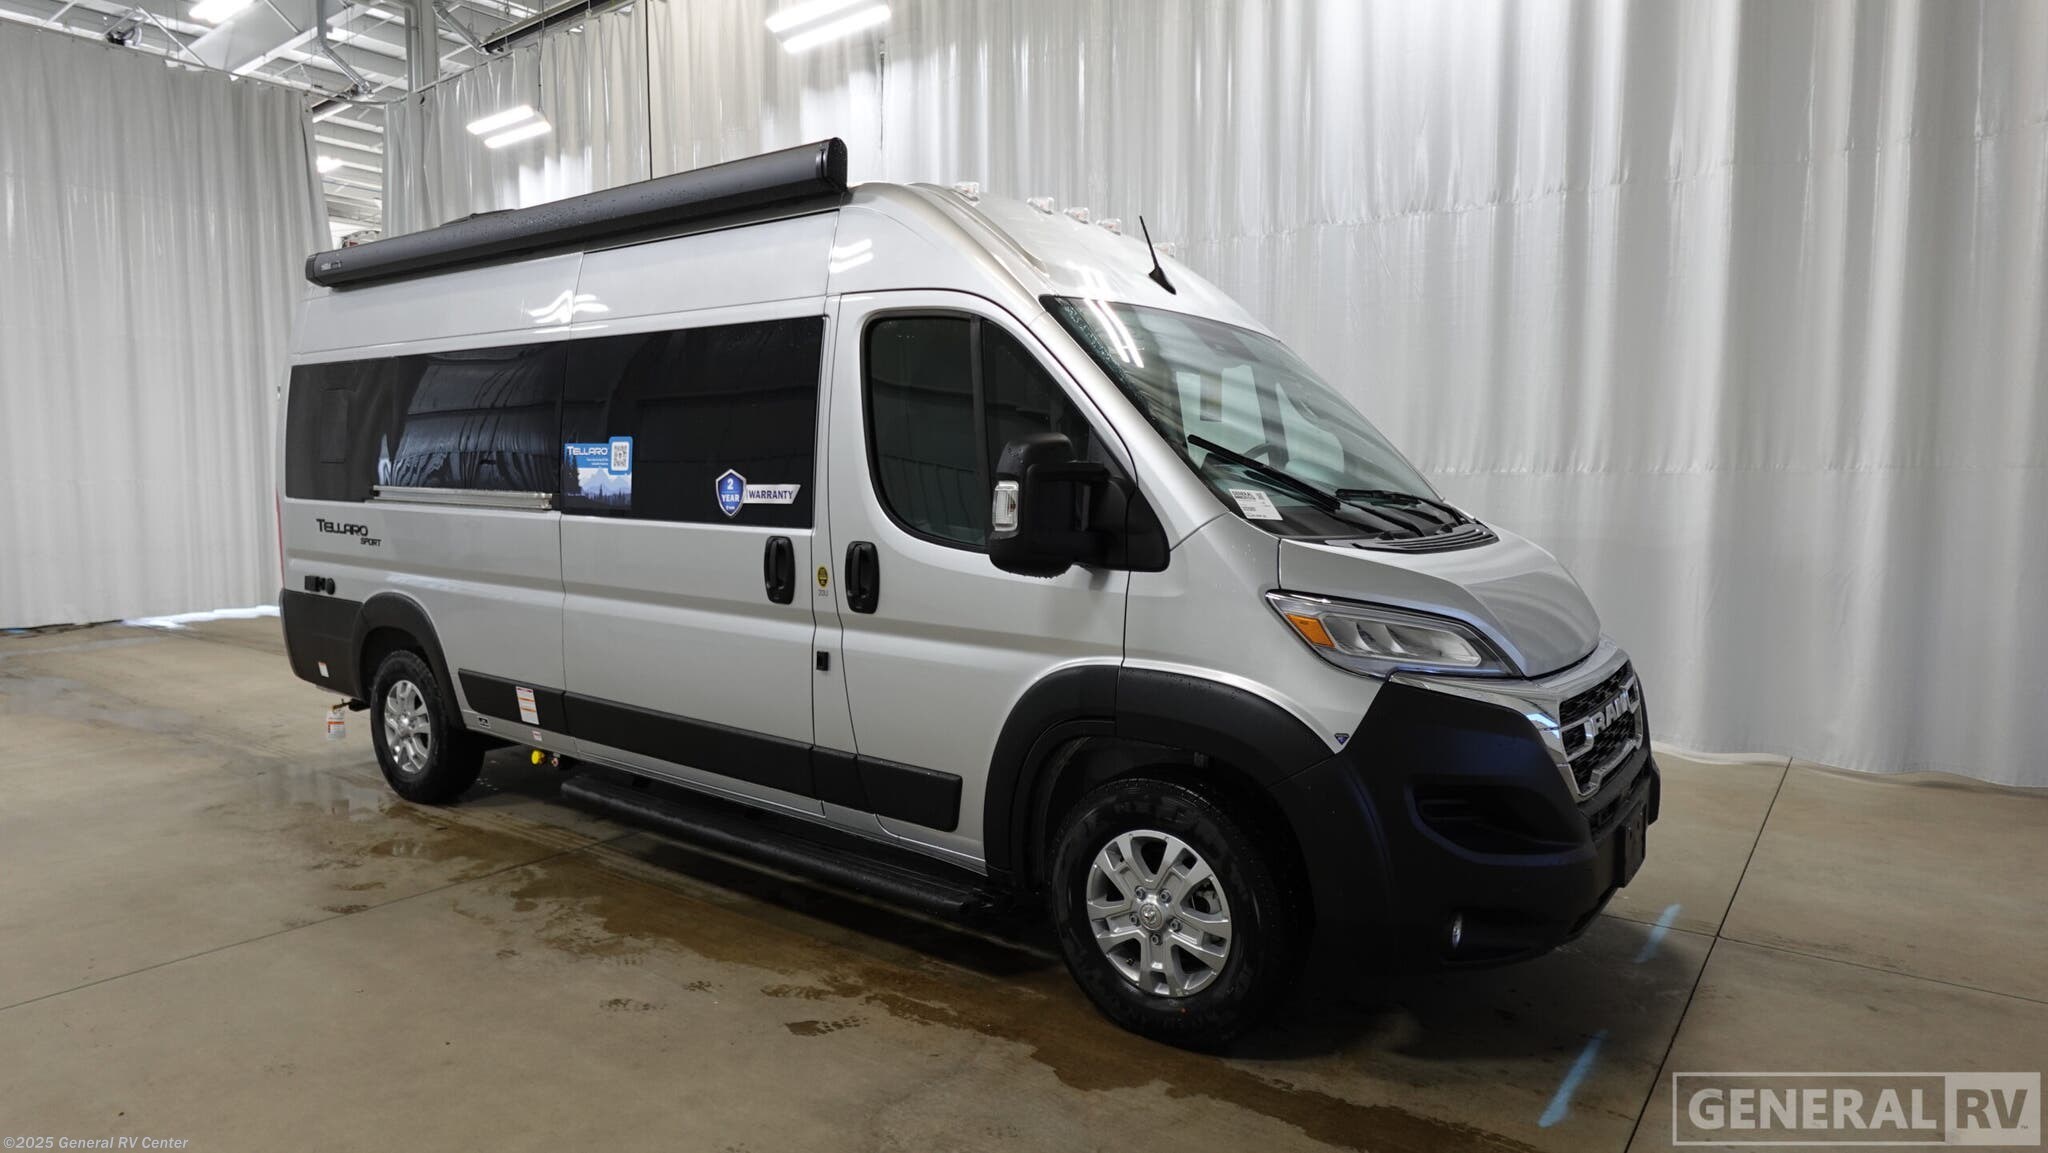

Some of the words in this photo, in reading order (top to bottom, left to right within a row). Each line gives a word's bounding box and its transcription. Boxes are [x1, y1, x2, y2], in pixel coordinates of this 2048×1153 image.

[566, 445, 608, 456] TELLARO
[726, 478, 735, 490] 2
[721, 494, 740, 503] YEAR
[748, 489, 794, 500] WARRANTY
[316, 518, 369, 537] TELLARO
[360, 537, 382, 548] SPORT
[1591, 690, 1629, 737] RAM
